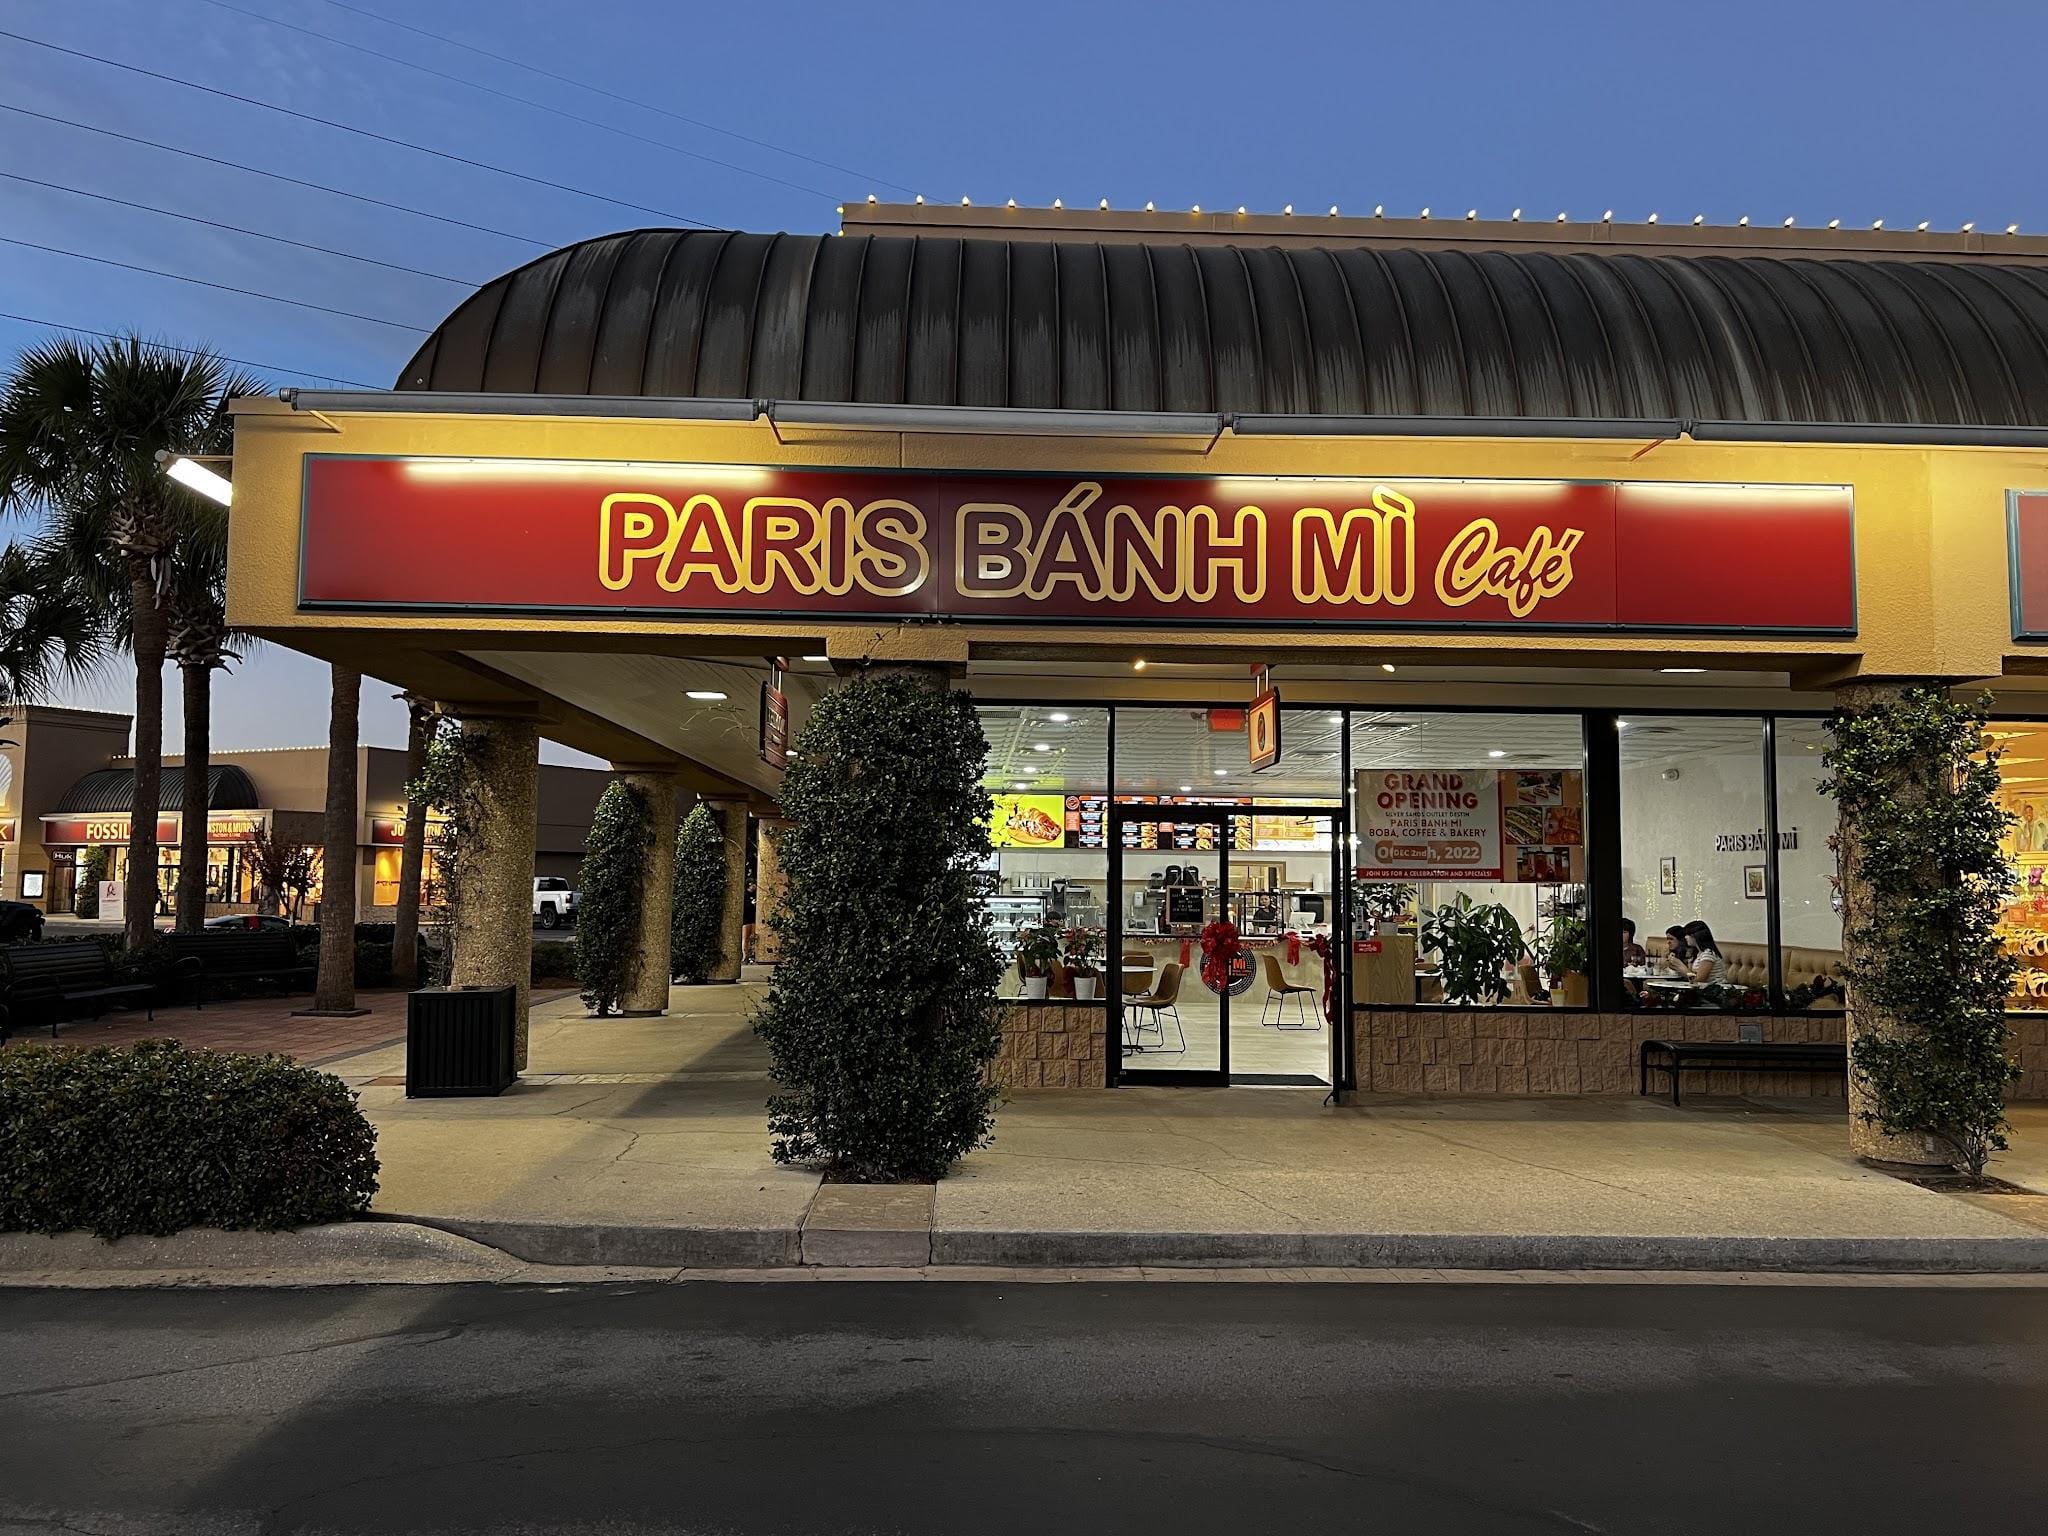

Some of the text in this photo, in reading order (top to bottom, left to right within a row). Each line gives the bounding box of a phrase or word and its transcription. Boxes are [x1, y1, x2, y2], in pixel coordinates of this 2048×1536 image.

[599, 482, 1584, 618] PARIS BÁNH MÌ Café
[1384, 773, 1463, 791] GRAND
[1377, 792, 1479, 809] OPENING
[86, 823, 130, 839] FOSSIL
[1390, 819, 1462, 827] PARIS BANH MI
[1369, 828, 1487, 838] BOBA, COFFEE & BAKERY
[1715, 834, 1747, 851] PARIS
[1393, 849, 1427, 857] DEC 2nd
[1444, 846, 1480, 859] 2022
